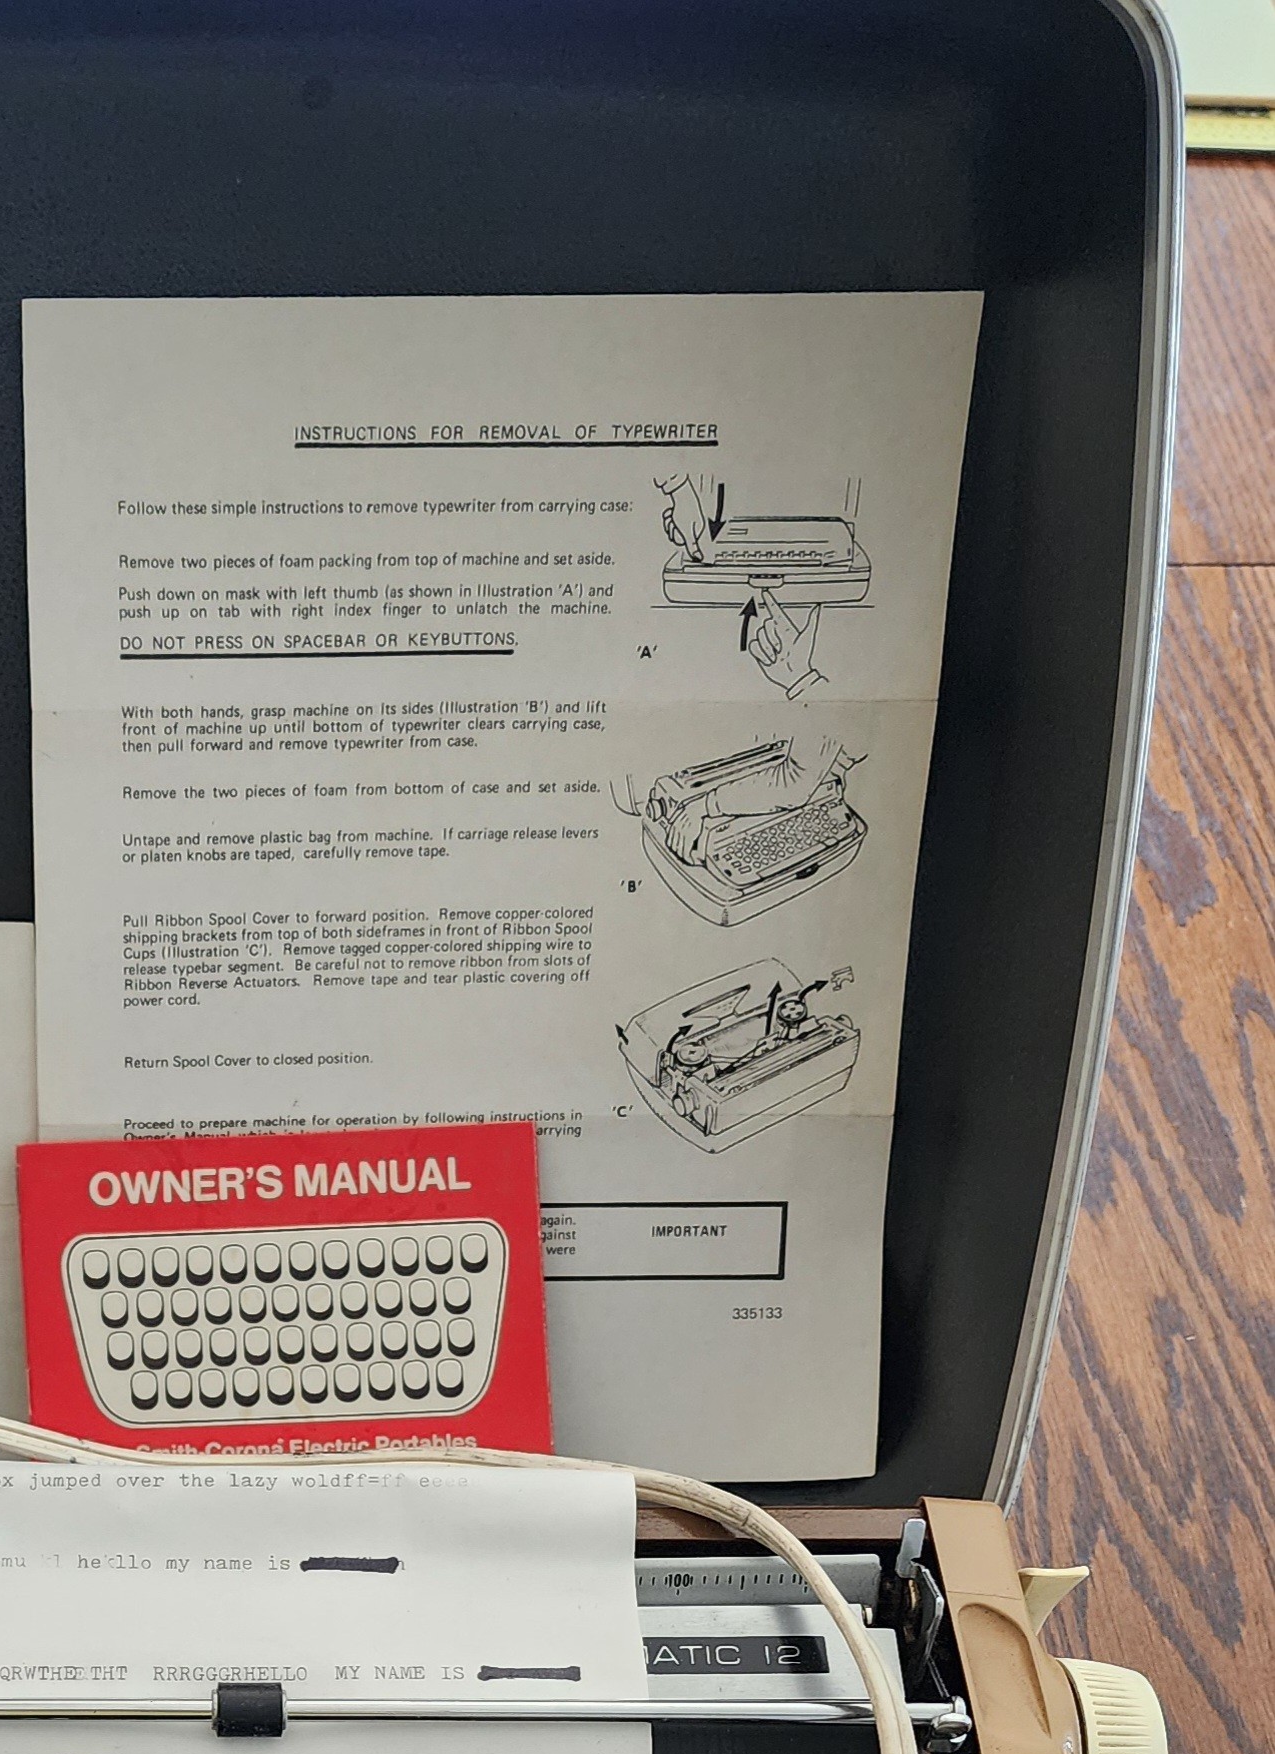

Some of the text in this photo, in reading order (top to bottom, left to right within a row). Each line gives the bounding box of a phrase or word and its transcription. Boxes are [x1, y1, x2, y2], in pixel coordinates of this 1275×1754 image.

[294, 423, 718, 441] INSTRUCTIONS FOR REMOVAL OF TYPEWRITER
[117, 497, 633, 518] Follow these simple instructions to remove typewriter from carrying case:
[118, 551, 615, 572] Remove two pieces of foam packing from top of machine and set aside.
[119, 631, 519, 651] DO NOT PRESS ON SPACEBAR OR KEYBUTTONS.
[124, 1051, 374, 1070] Return Spool Cover to closed position.
[89, 1157, 471, 1206] OWNER'S MANUAL
[652, 1225, 727, 1237] IMPORTANT
[546, 1247, 575, 1255] were
[733, 1307, 782, 1319] 335133
[376, 1433, 477, 1451] Portables
[28, 1472, 102, 1491] jumped
[115, 1476, 165, 1488] over
[178, 1473, 215, 1488] the
[226, 1471, 278, 1492] lazy
[165, 1559, 190, 1573] my
[204, 1559, 252, 1572] name
[269, 1556, 290, 1570] is
[669, 1574, 690, 1587] 100
[765, 1646, 800, 1664] 12
[335, 1666, 360, 1680] MY
[374, 1666, 425, 1679] NAME
[441, 1667, 464, 1680] IS
